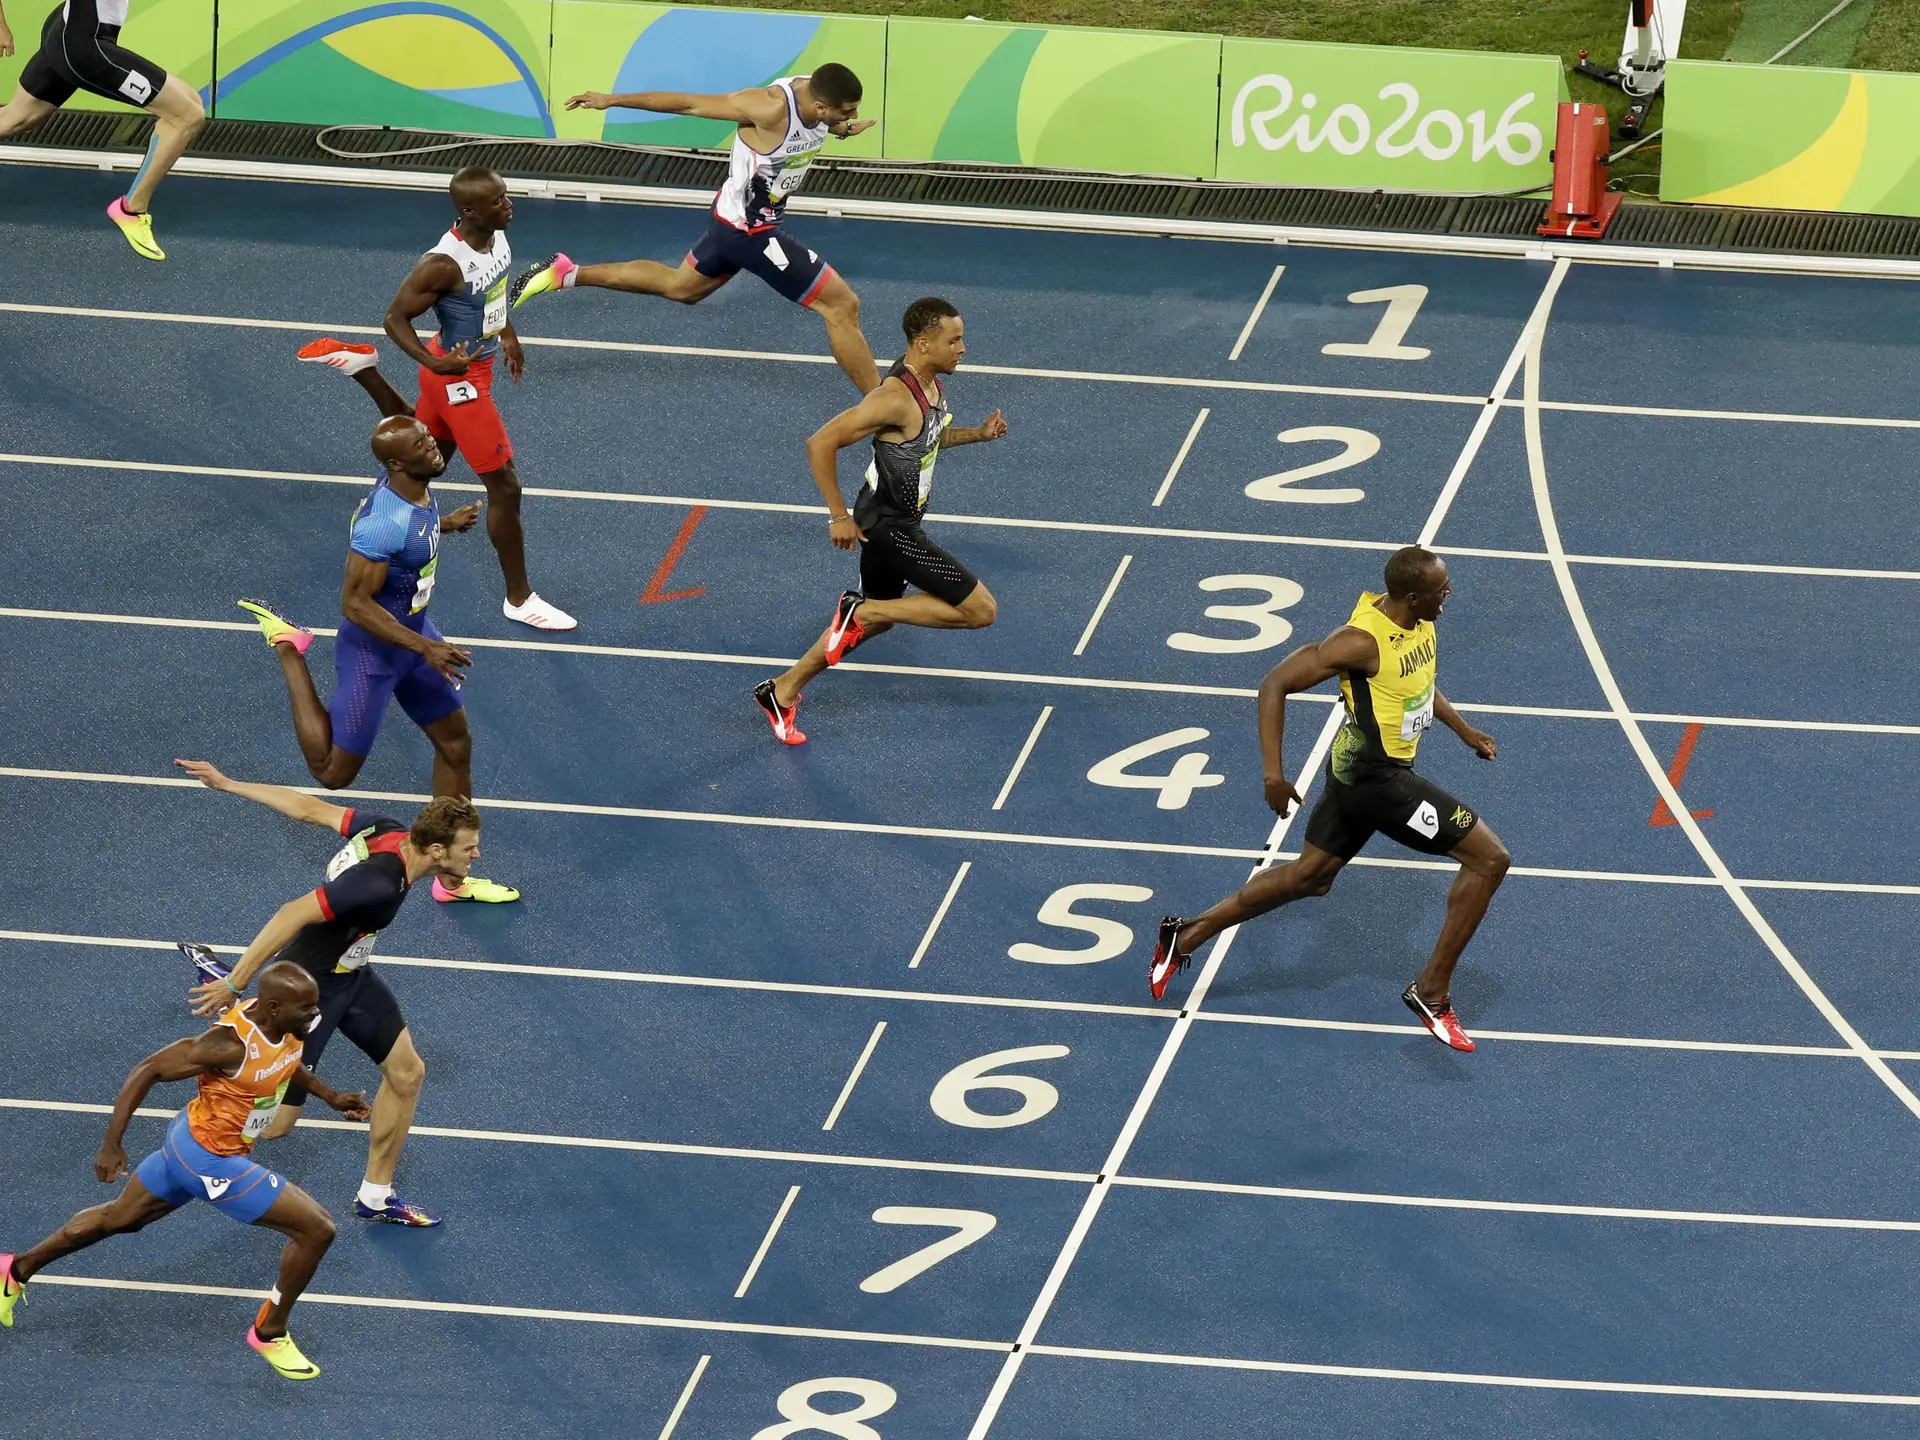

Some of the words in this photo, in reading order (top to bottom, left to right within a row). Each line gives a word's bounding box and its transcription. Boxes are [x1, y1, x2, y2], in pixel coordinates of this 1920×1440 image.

[129, 82, 146, 95] 1
[786, 142, 809, 154] GREAT
[1321, 284, 1432, 361] 1
[1244, 426, 1382, 504] 2
[1166, 573, 1305, 654] 3
[1086, 727, 1225, 810] 4
[1008, 884, 1154, 965] 5
[251, 1116, 272, 1130] MA
[930, 1045, 1071, 1129] 6
[860, 1206, 997, 1294] 7
[750, 1376, 898, 1440] 8
